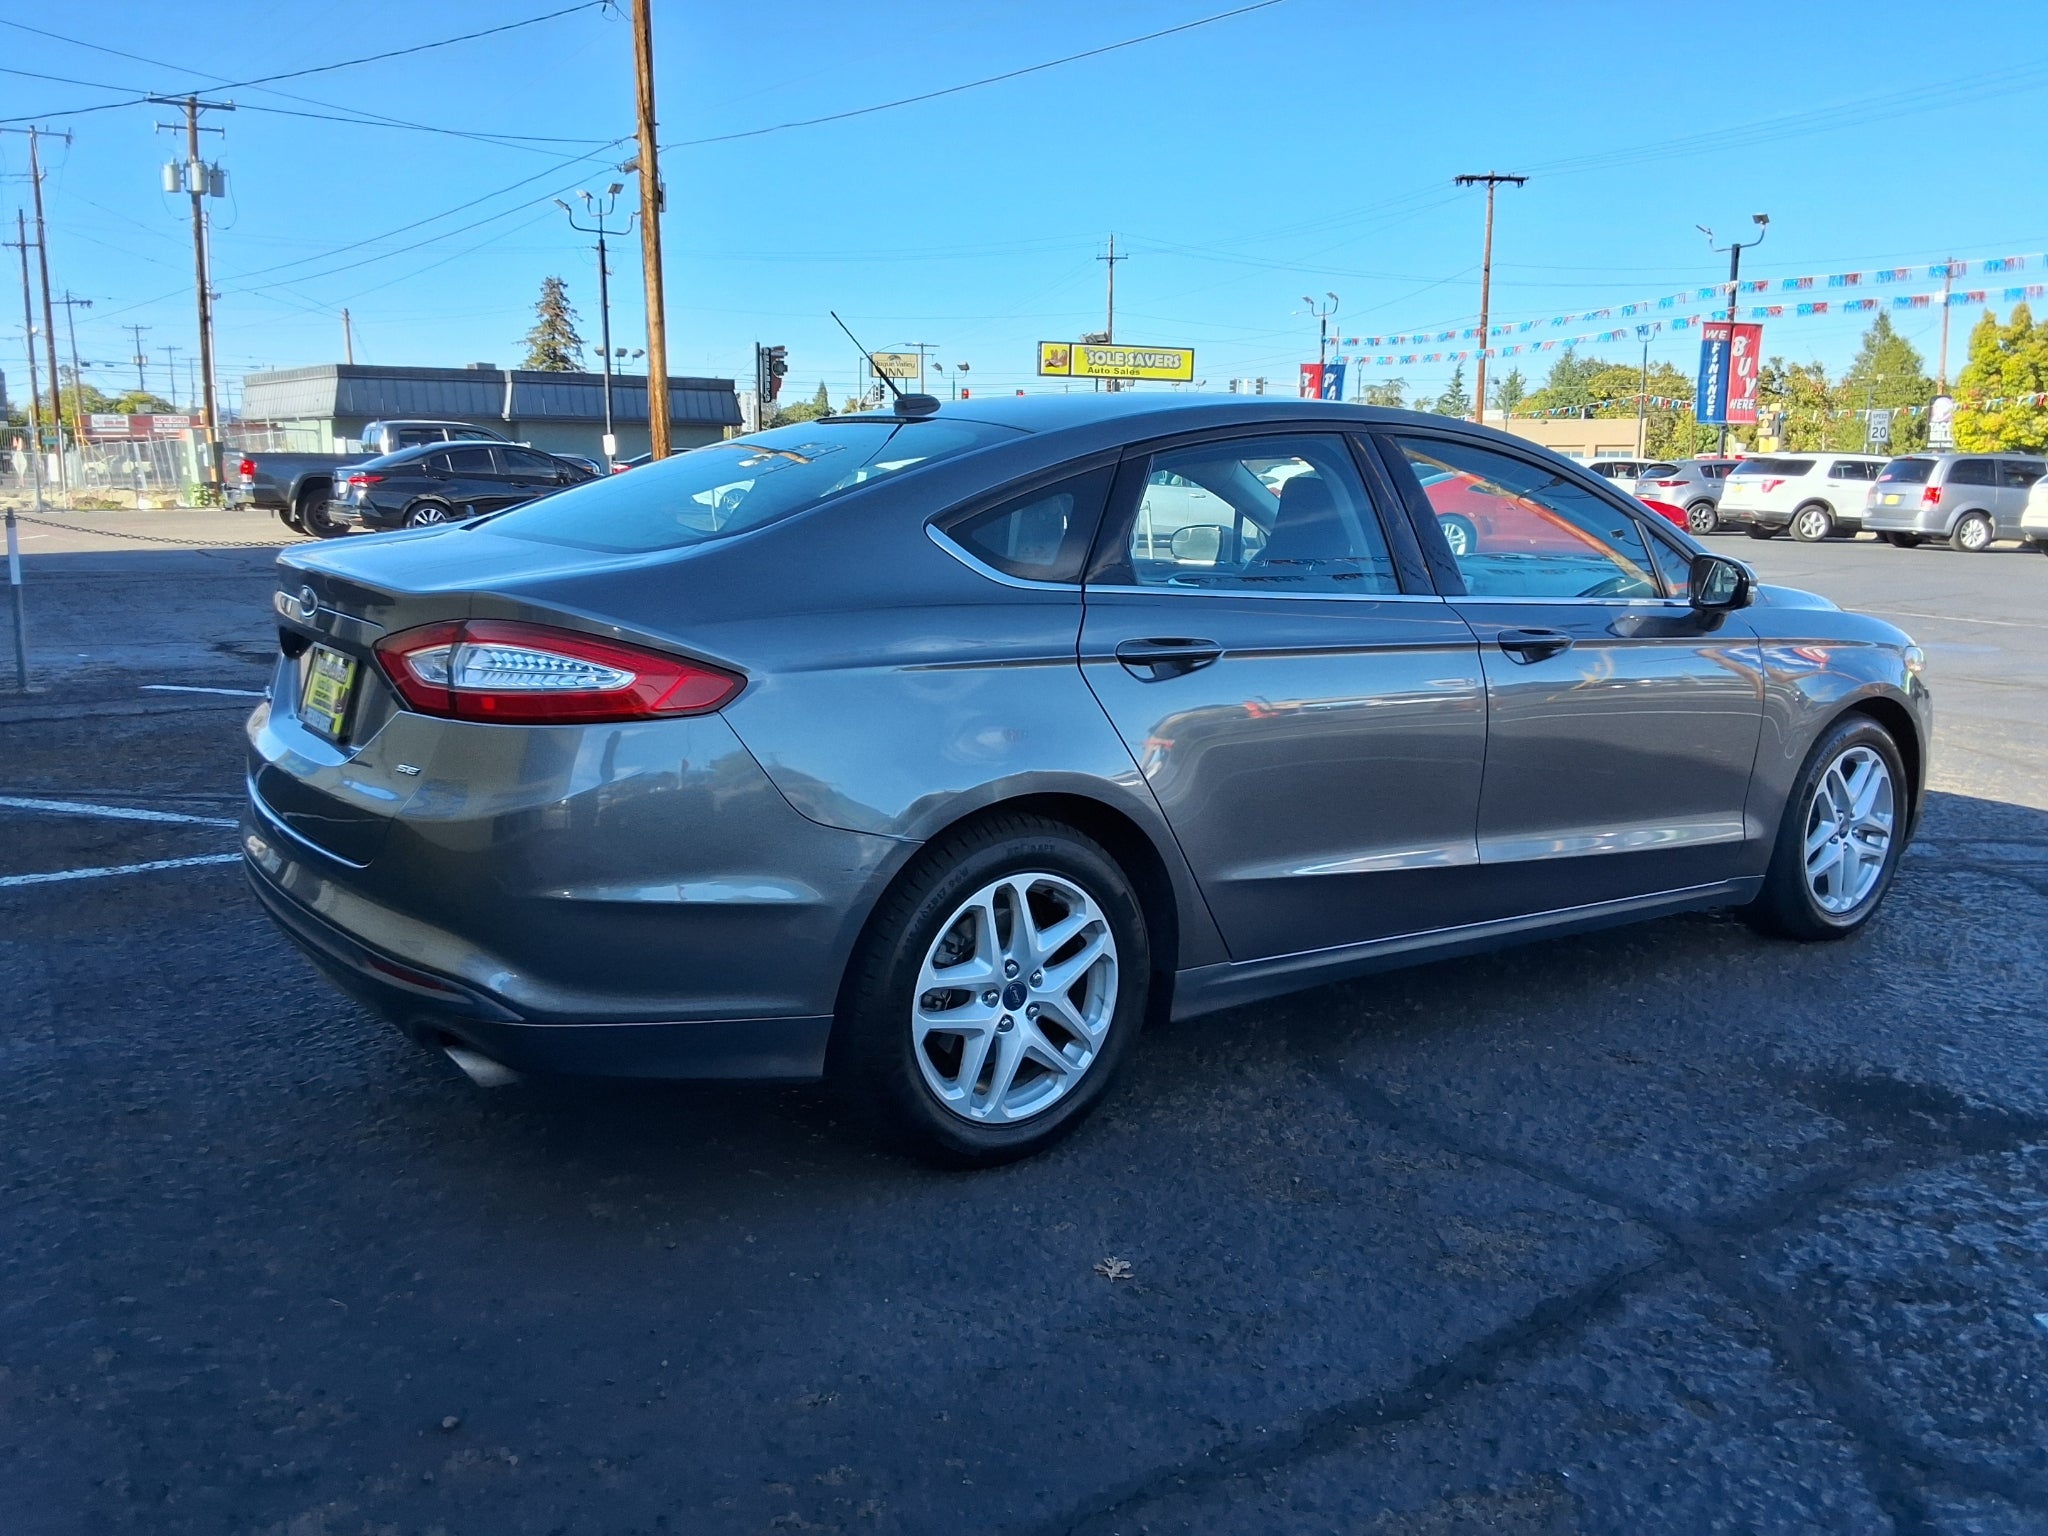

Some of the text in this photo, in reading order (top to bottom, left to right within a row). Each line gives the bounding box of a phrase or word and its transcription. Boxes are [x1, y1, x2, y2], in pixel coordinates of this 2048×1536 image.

[1705, 329, 1728, 339] WE
[1087, 350, 1182, 369] SOLE SAVERS
[885, 367, 904, 376] INN
[1087, 366, 1141, 376] Auto Sales
[1733, 335, 1757, 398] BUY
[1706, 342, 1721, 416] FINANCE
[1729, 398, 1756, 410] HERE
[1871, 426, 1887, 439] 20
[395, 764, 420, 776] SE
